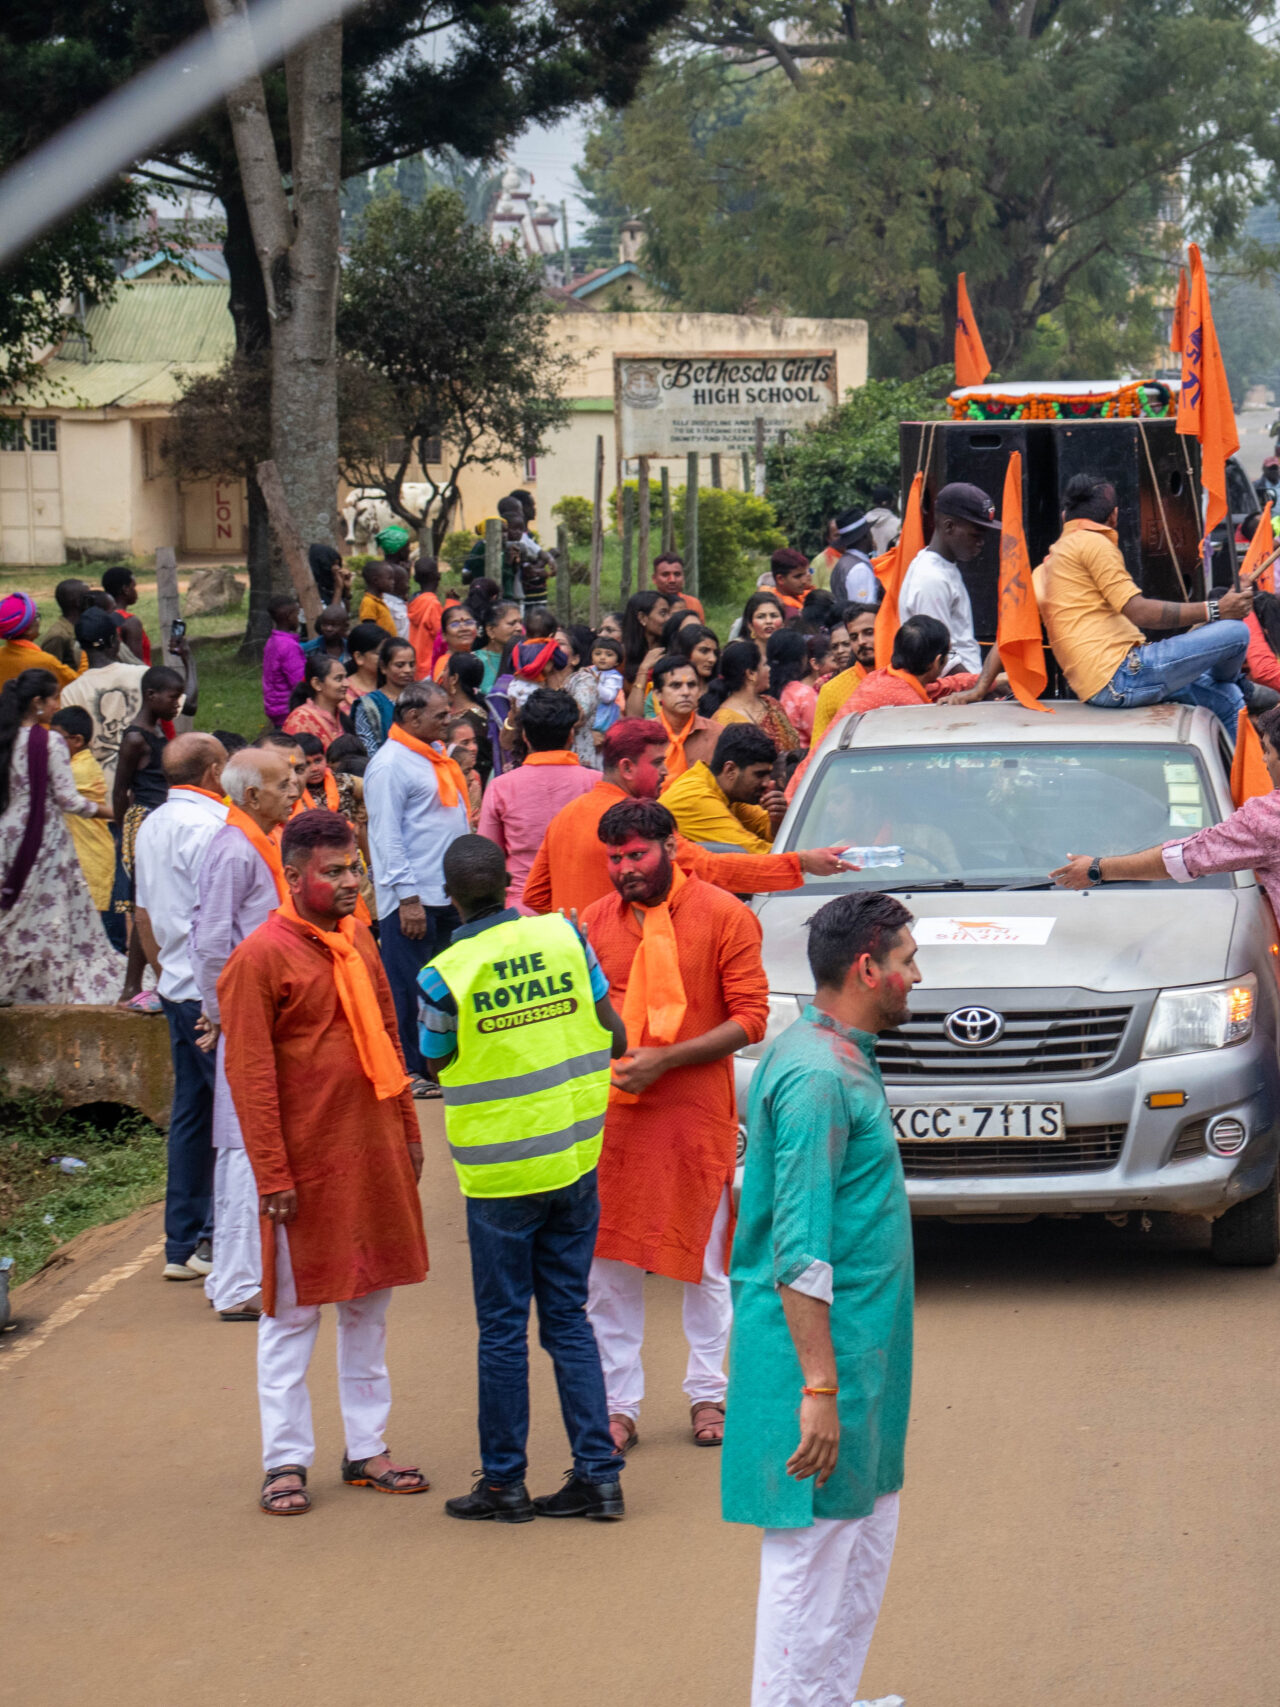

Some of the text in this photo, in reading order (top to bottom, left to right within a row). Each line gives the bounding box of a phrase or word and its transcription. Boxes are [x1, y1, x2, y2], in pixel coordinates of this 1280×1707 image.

[662, 359, 832, 390] Bethesda Girls
[693, 386, 820, 405] HIGH SCHOOL
[493, 951, 546, 980] THE
[472, 971, 573, 1013] ROYALS
[890, 1105, 1059, 1138] KCC 711S
